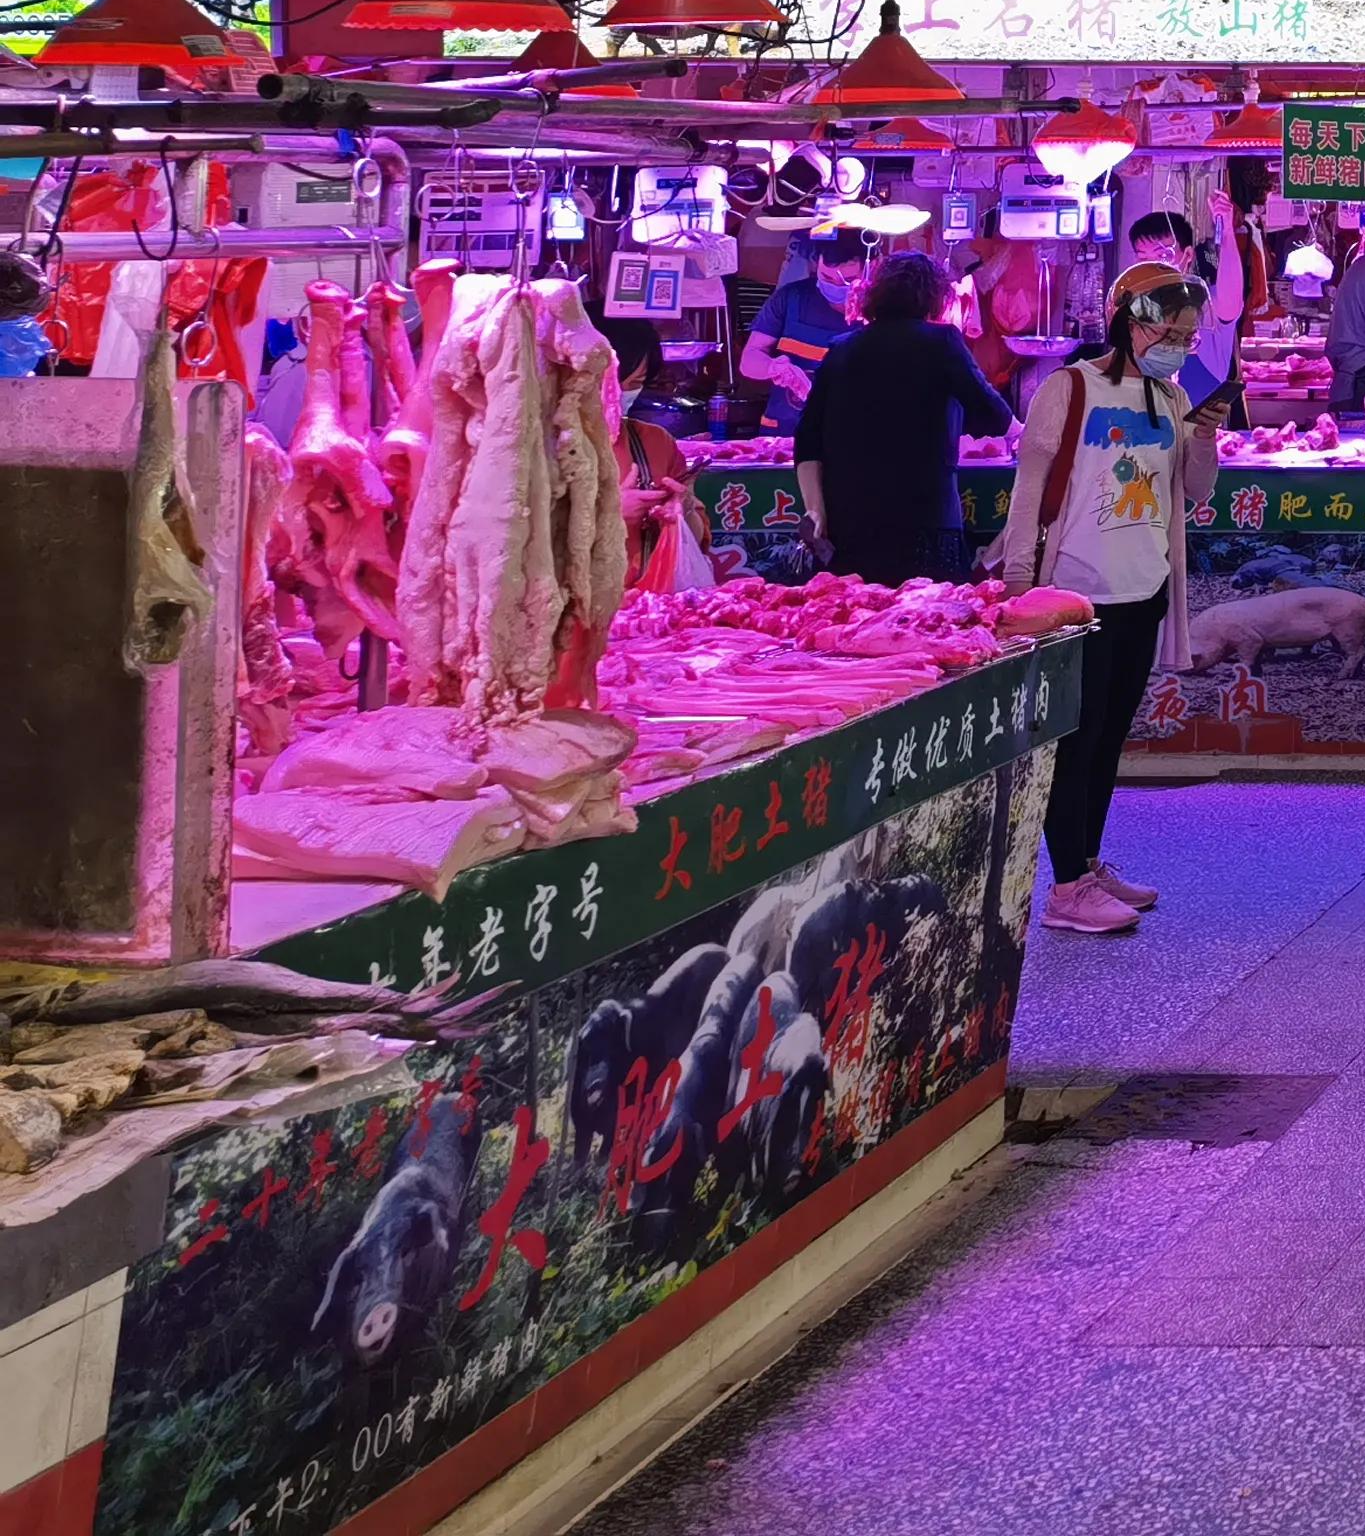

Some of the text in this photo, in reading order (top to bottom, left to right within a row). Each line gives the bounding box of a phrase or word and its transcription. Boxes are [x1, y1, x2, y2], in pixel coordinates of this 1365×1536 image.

[655, 761, 833, 901] 大肥土猪
[864, 670, 1050, 805] 专做优质土猪肉
[458, 922, 888, 1312] 大肥土猪
